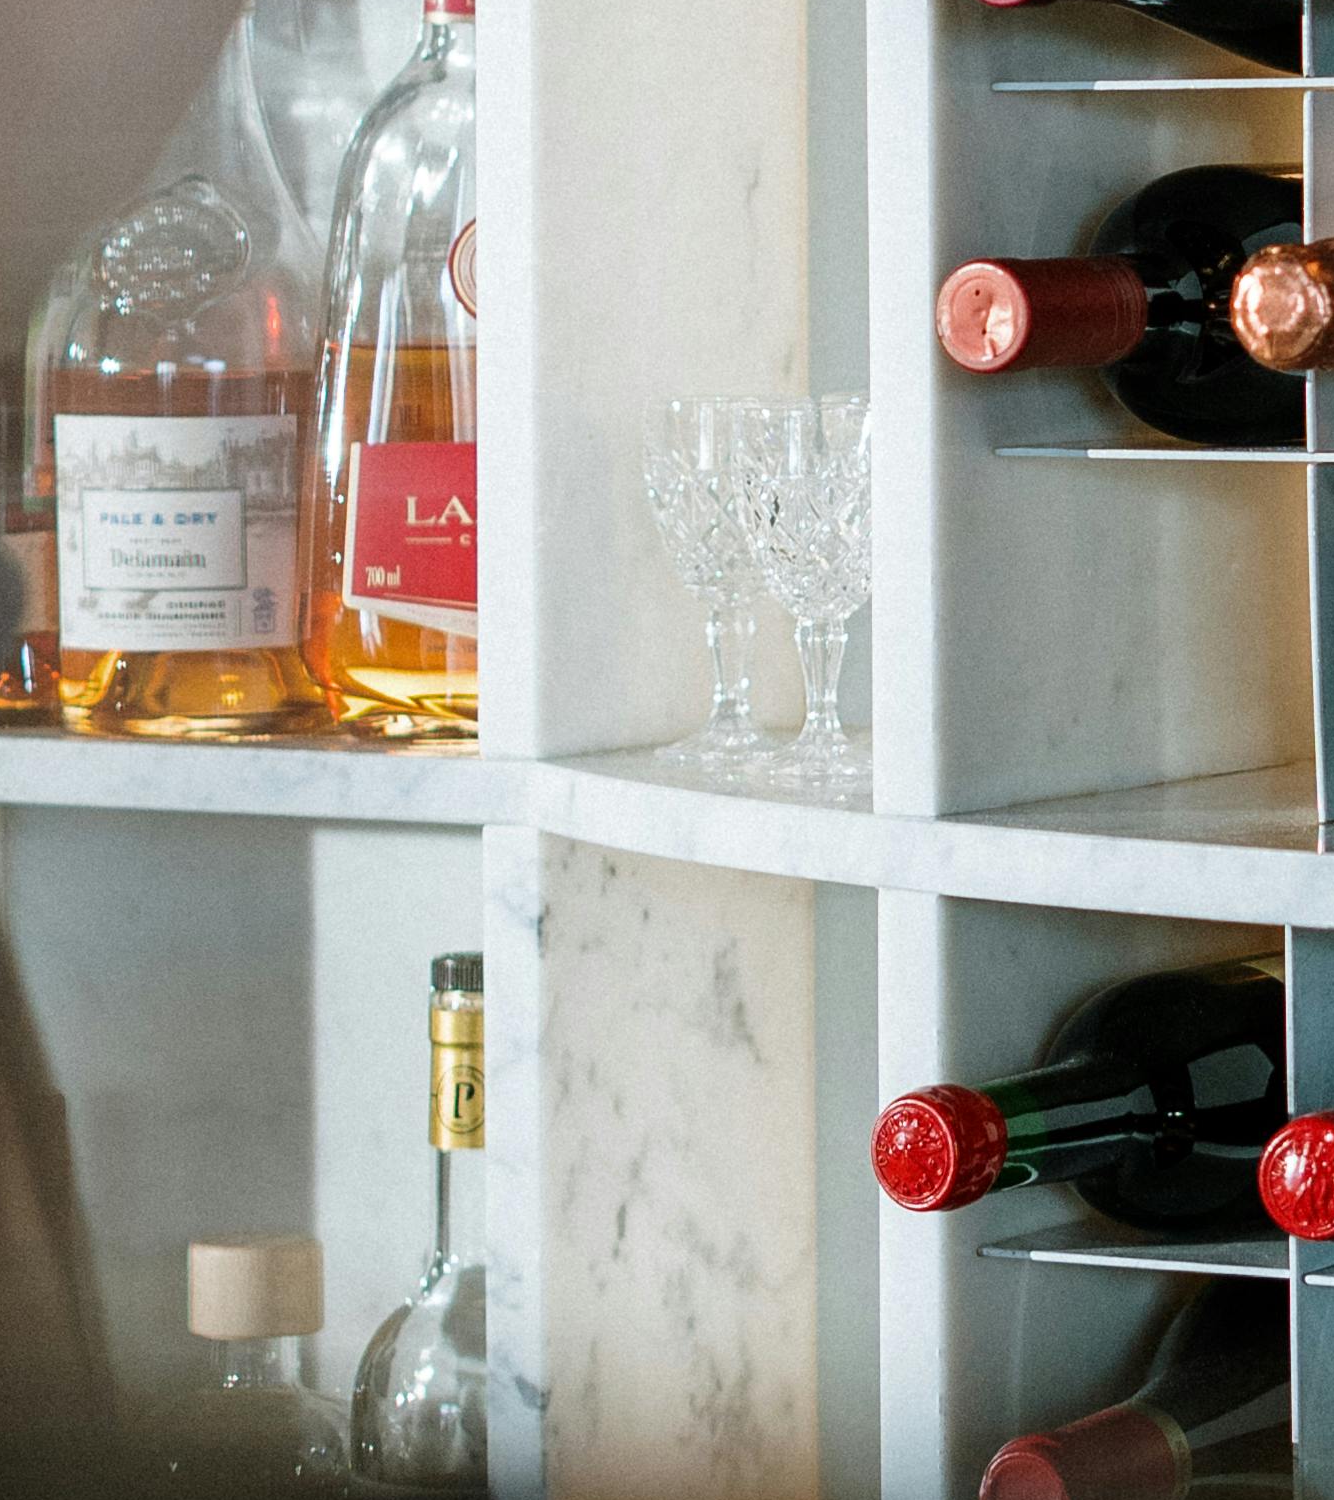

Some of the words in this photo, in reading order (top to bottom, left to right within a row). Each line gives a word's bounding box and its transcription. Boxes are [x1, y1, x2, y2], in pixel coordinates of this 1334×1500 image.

[99, 510, 143, 525] PALE
[152, 510, 164, 525] &
[174, 510, 217, 525] DRY
[365, 565, 385, 587] 700
[387, 564, 401, 588] ml
[453, 1082, 475, 1119] P
